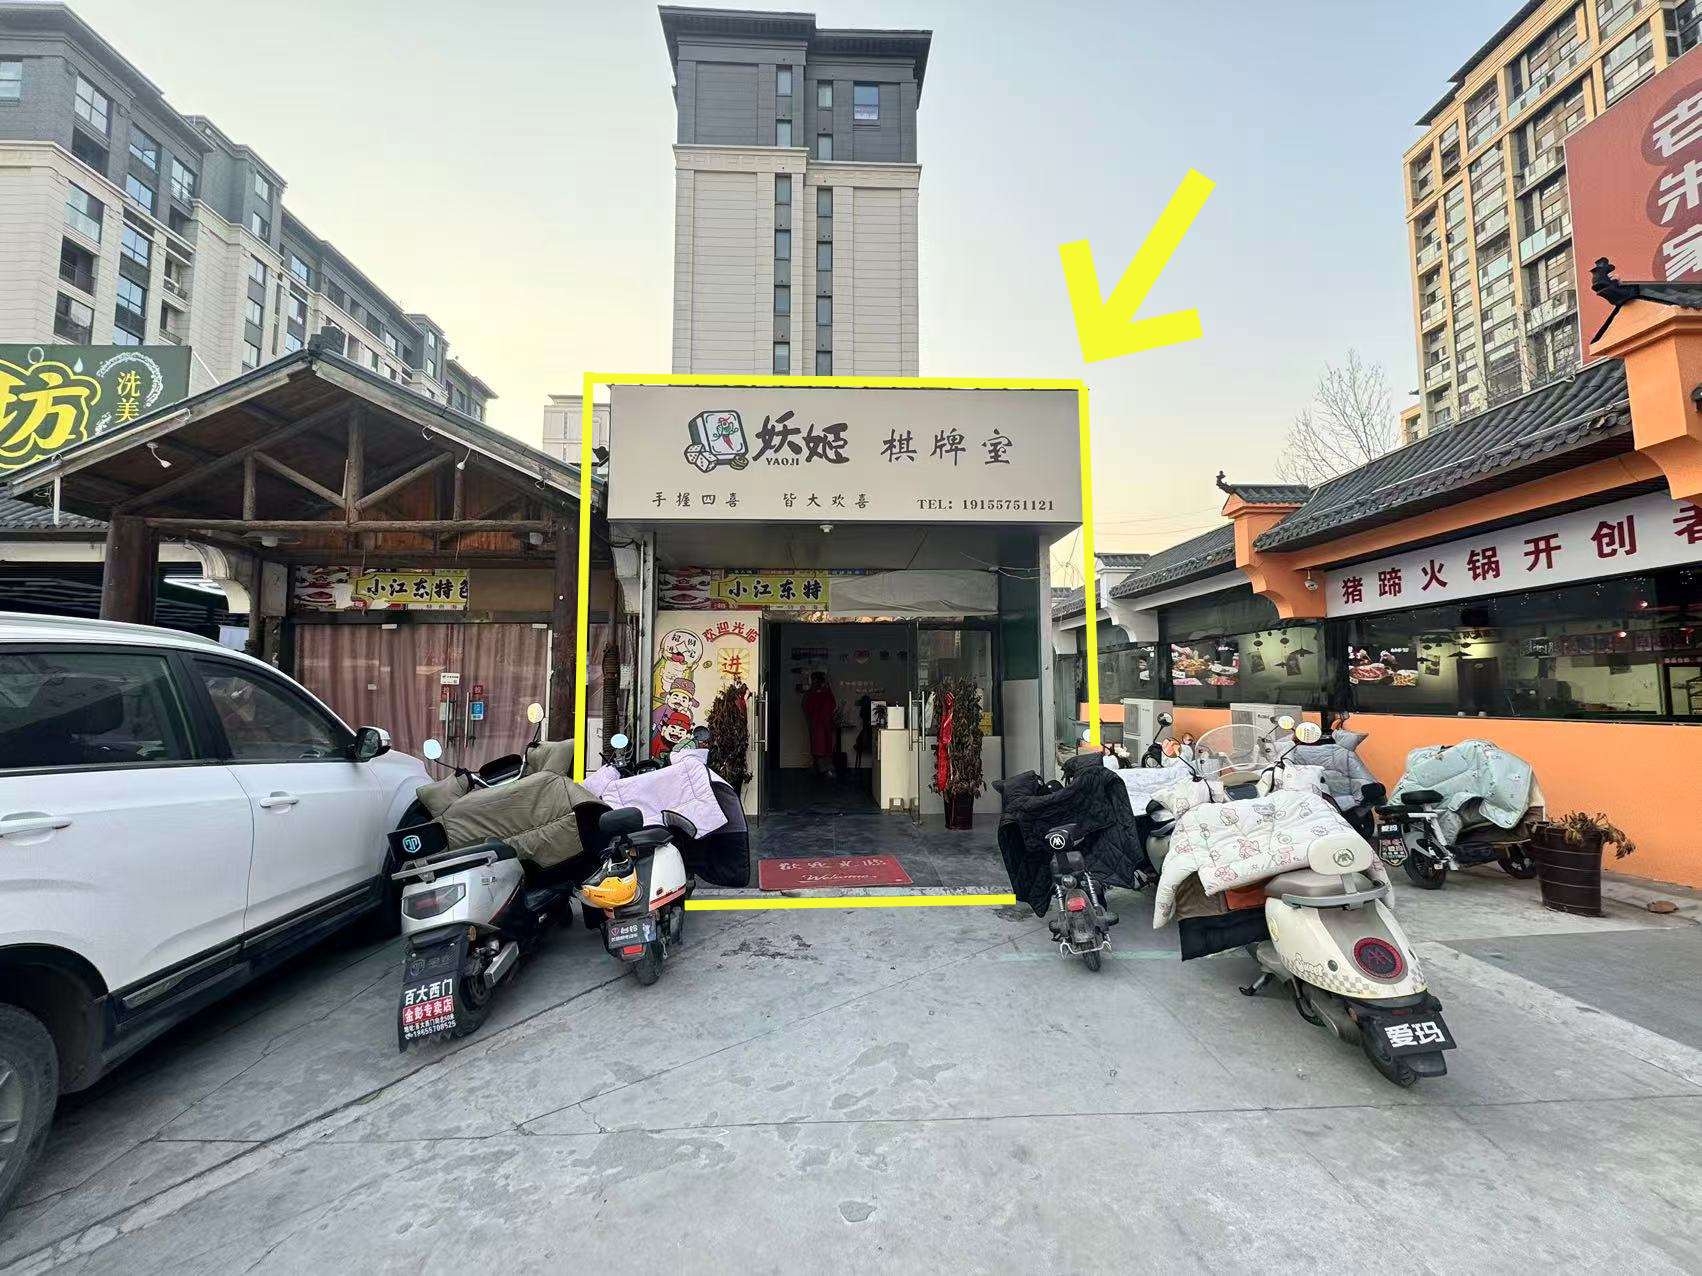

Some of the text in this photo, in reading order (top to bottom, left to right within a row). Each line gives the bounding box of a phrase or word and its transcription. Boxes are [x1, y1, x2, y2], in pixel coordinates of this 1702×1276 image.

[116, 370, 141, 424] 洗美
[752, 410, 1013, 466] 妖姬 棋牌室
[765, 457, 800, 466] YAOJI
[652, 491, 869, 509] 手握四喜 皆大欢喜
[962, 499, 1055, 511] 19155751121
[728, 579, 822, 600] 小江东特
[702, 621, 760, 643] 欢迎光临
[404, 978, 453, 1006] 百大西门
[1384, 1021, 1446, 1048] 爱玛
